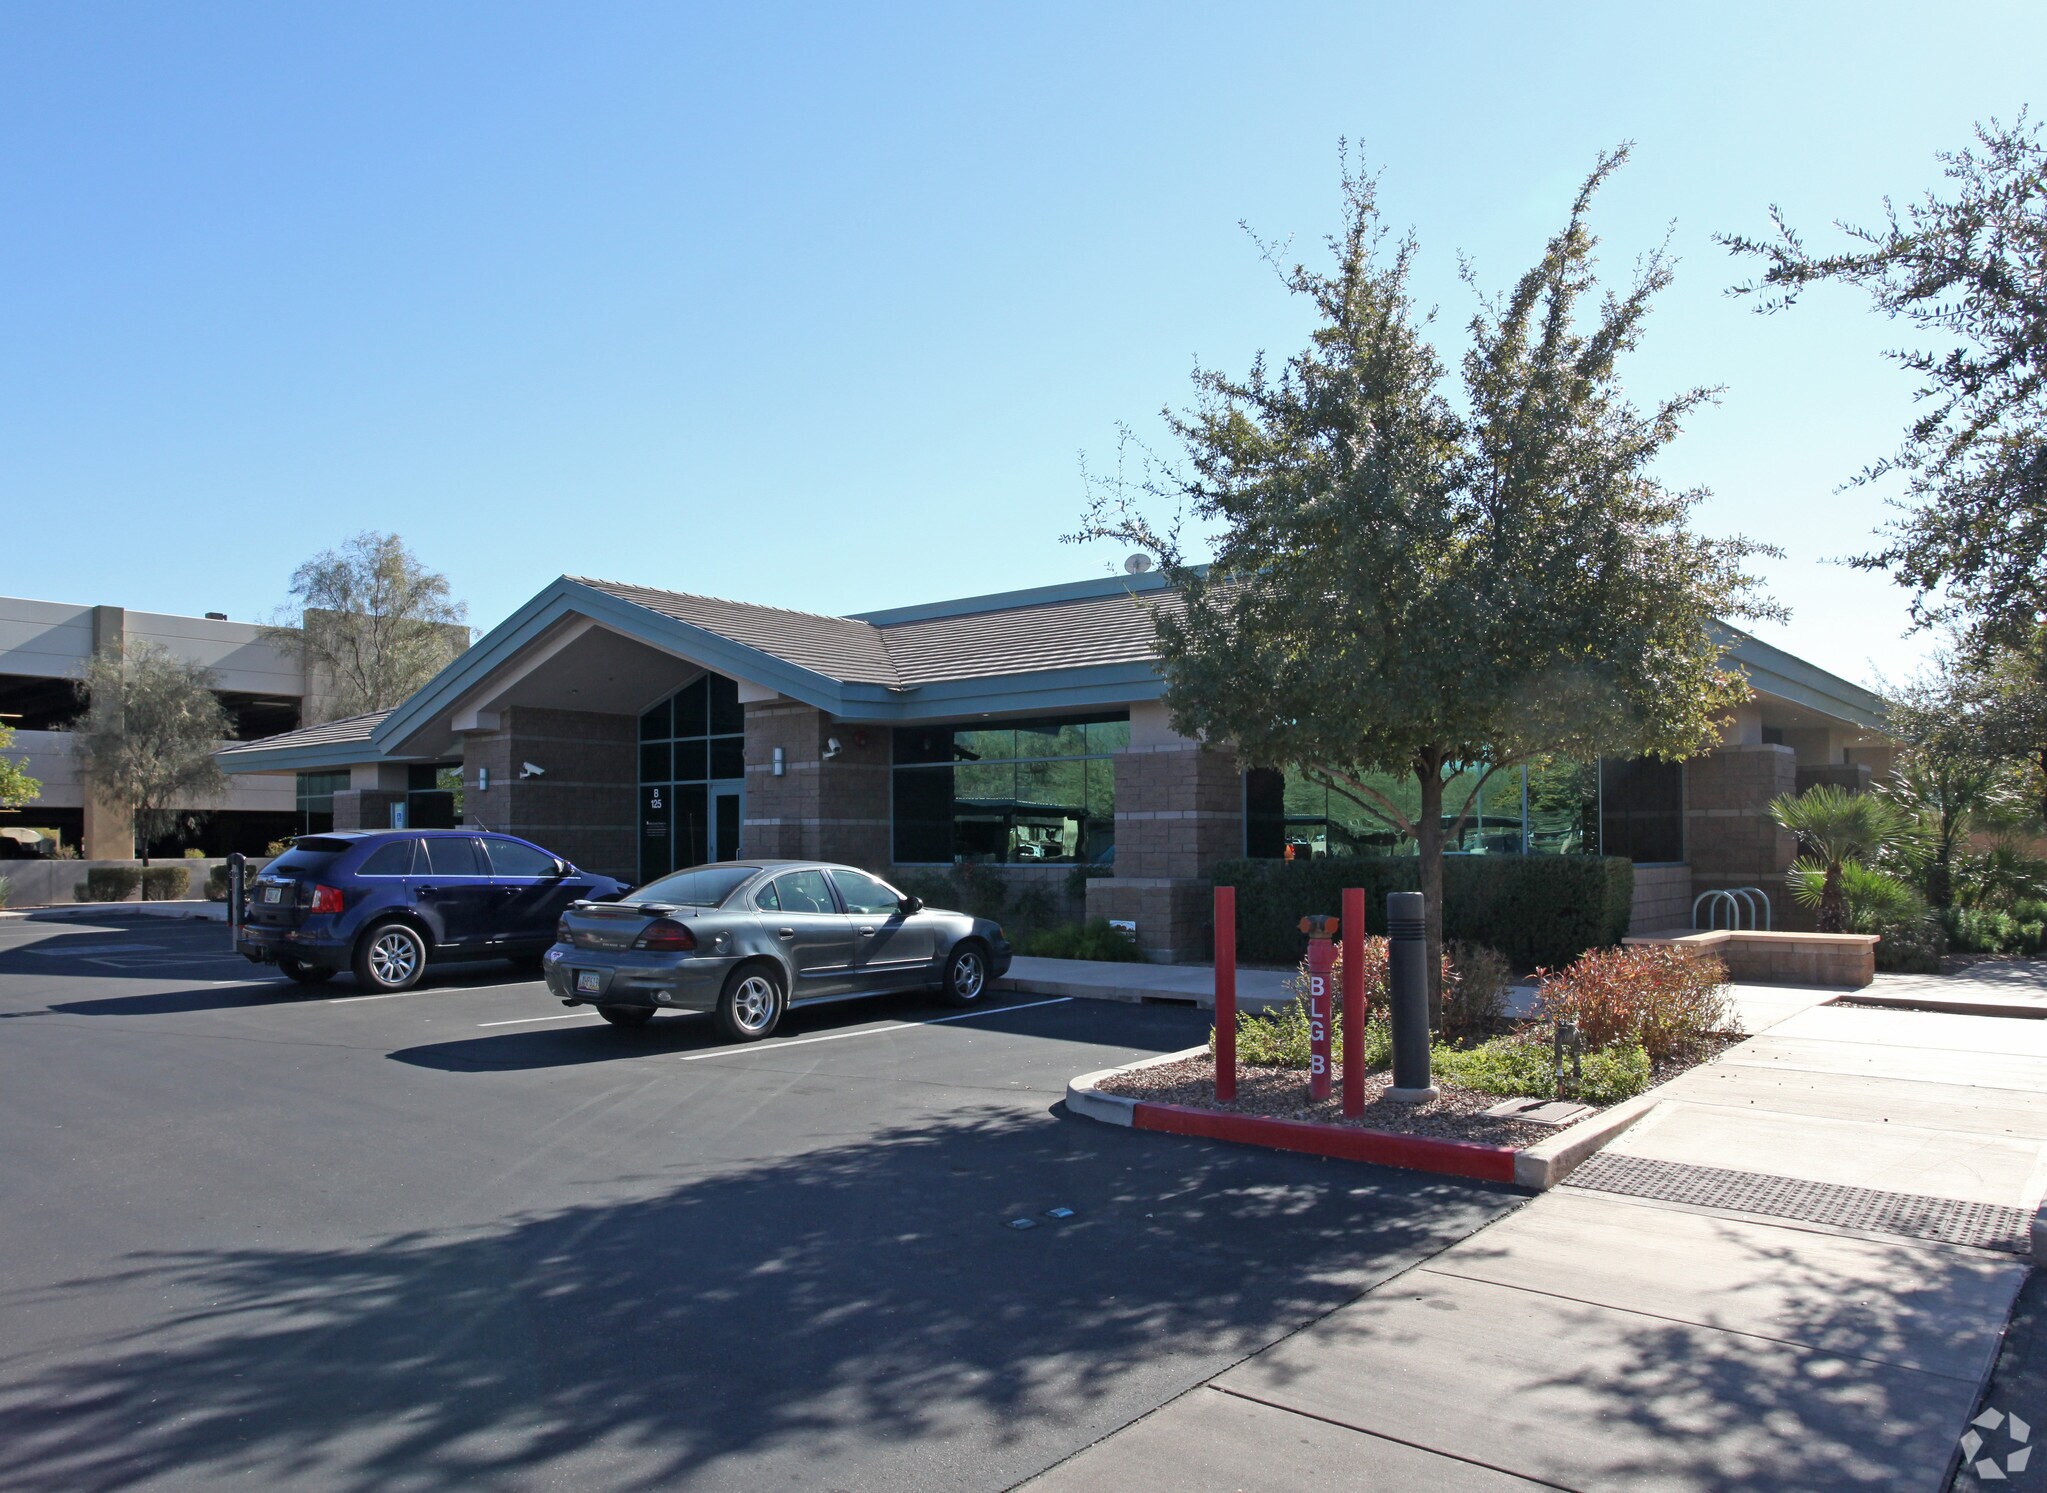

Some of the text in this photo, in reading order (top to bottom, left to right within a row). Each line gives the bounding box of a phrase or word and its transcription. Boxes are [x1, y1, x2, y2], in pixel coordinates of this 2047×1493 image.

[653, 788, 660, 798] B
[650, 799, 662, 809] 125
[1310, 976, 1326, 1075] BLG B
